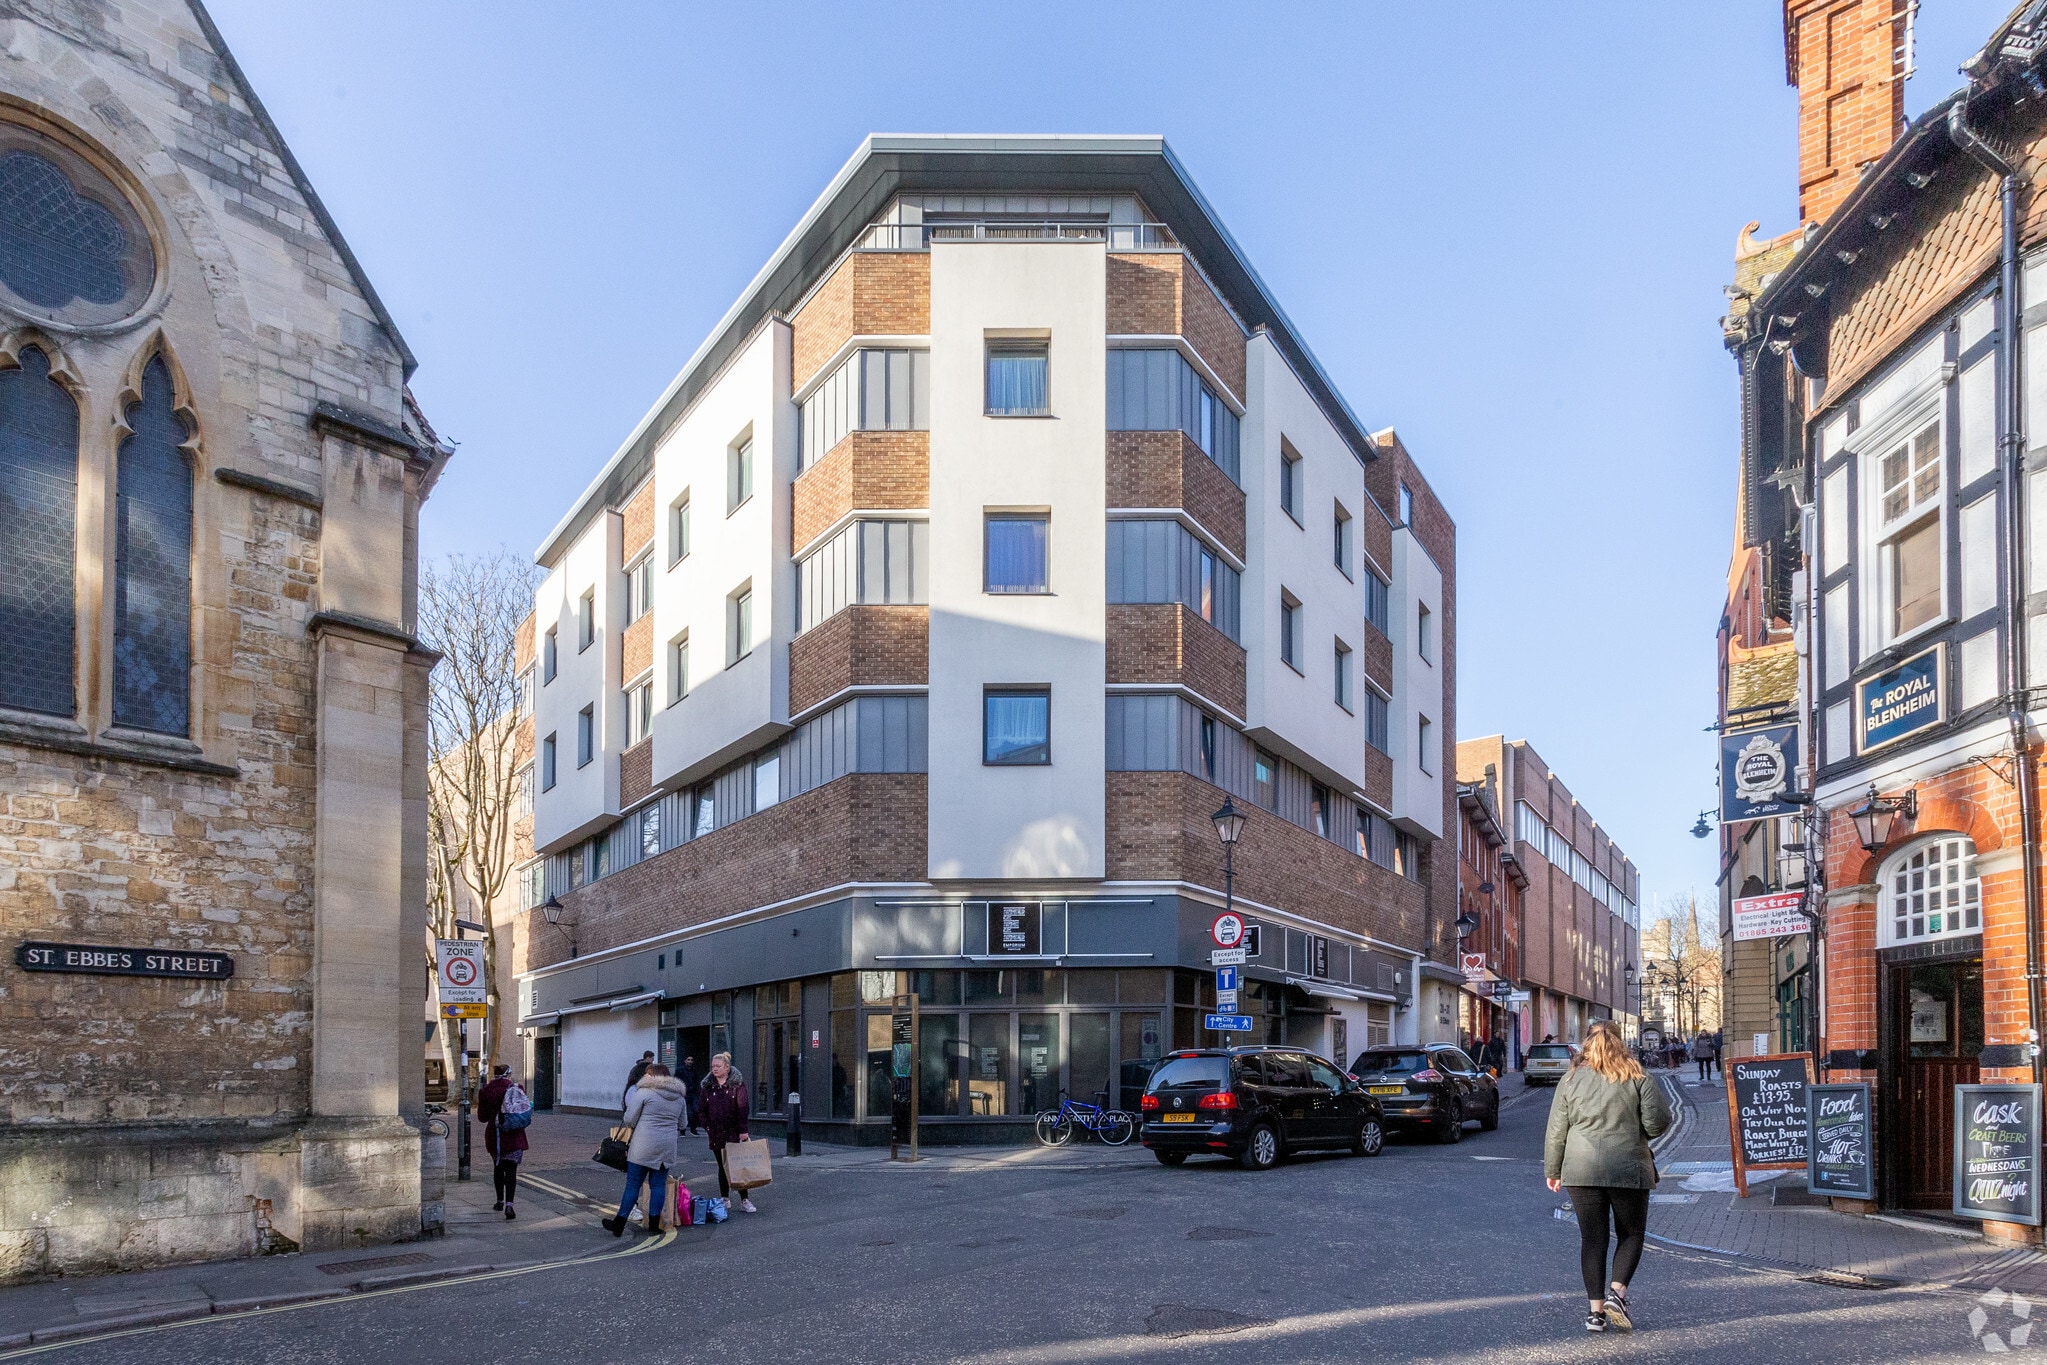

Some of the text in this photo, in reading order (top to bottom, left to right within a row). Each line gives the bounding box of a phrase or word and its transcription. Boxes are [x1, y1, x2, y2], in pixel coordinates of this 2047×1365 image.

[1870, 675, 1930, 714] The ROYAL
[1867, 690, 1936, 732] BLENHEIM
[1747, 762, 1772, 770] ROYAL
[1743, 768, 1776, 779] BLENHEIM
[1741, 898, 1799, 911] Extra
[1741, 913, 1769, 921] Electrical
[1772, 910, 1787, 918] Light
[1784, 916, 1806, 924] Cutting
[1740, 929, 1766, 937] 01865
[1770, 926, 1787, 934] 243
[446, 948, 474, 956] ZONE
[1214, 951, 1234, 959] Except
[28, 950, 222, 972] ST. EBBE'S STREET
[1737, 1065, 1780, 1080] SUNDAY
[1760, 1080, 1802, 1092] ROASTS
[1820, 1094, 1857, 1116] Food
[1973, 1100, 2023, 1124] Cask
[1839, 1126, 1854, 1136] DAILY
[1968, 1128, 2027, 1143] CRAFT BEERS
[1791, 1138, 1799, 1146] 2
[1828, 1139, 1855, 1154] HOT
[1969, 1160, 2026, 1173] WEDNESDAYS
[1968, 1178, 2028, 1203] QUIZ night
